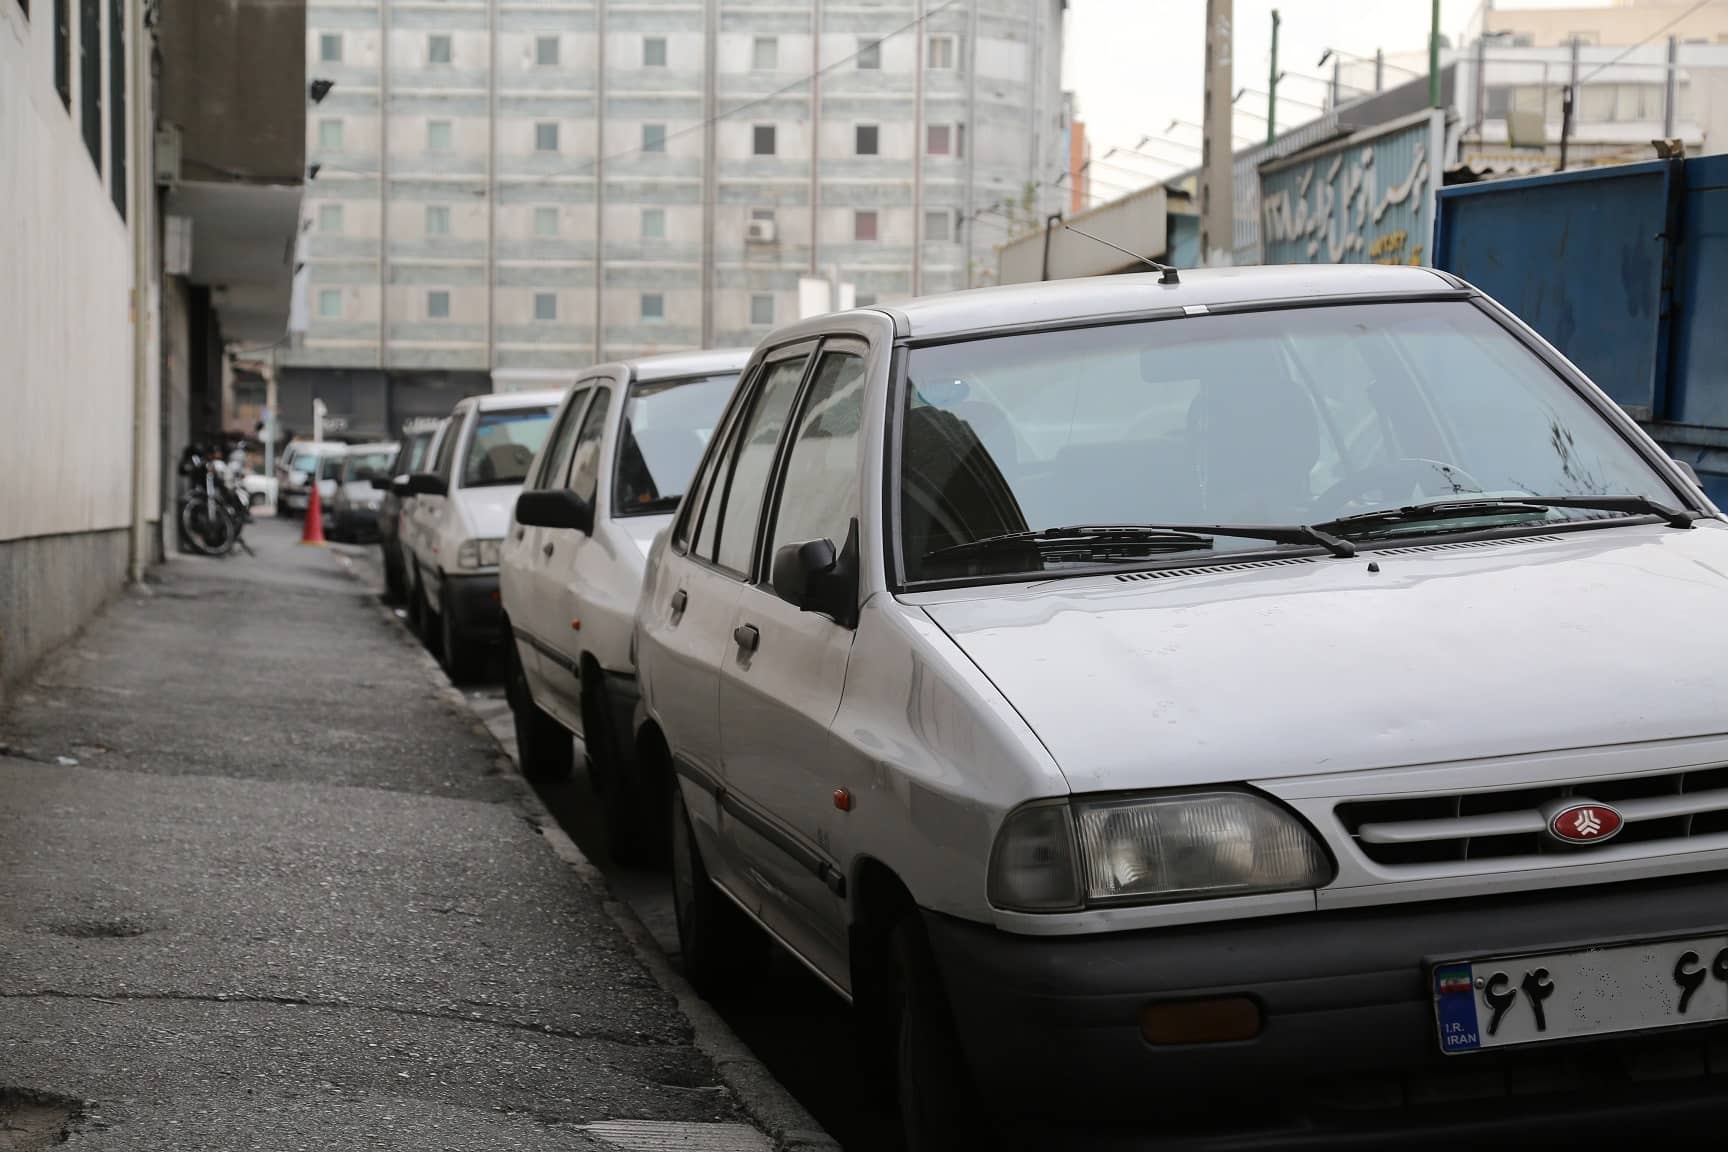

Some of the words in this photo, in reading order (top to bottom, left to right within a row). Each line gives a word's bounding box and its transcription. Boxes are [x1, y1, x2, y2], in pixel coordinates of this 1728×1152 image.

[1484, 968, 1554, 1036] ۶۴
[1446, 1022, 1465, 1033] I.R.
[1447, 1033, 1477, 1046] IRAN
